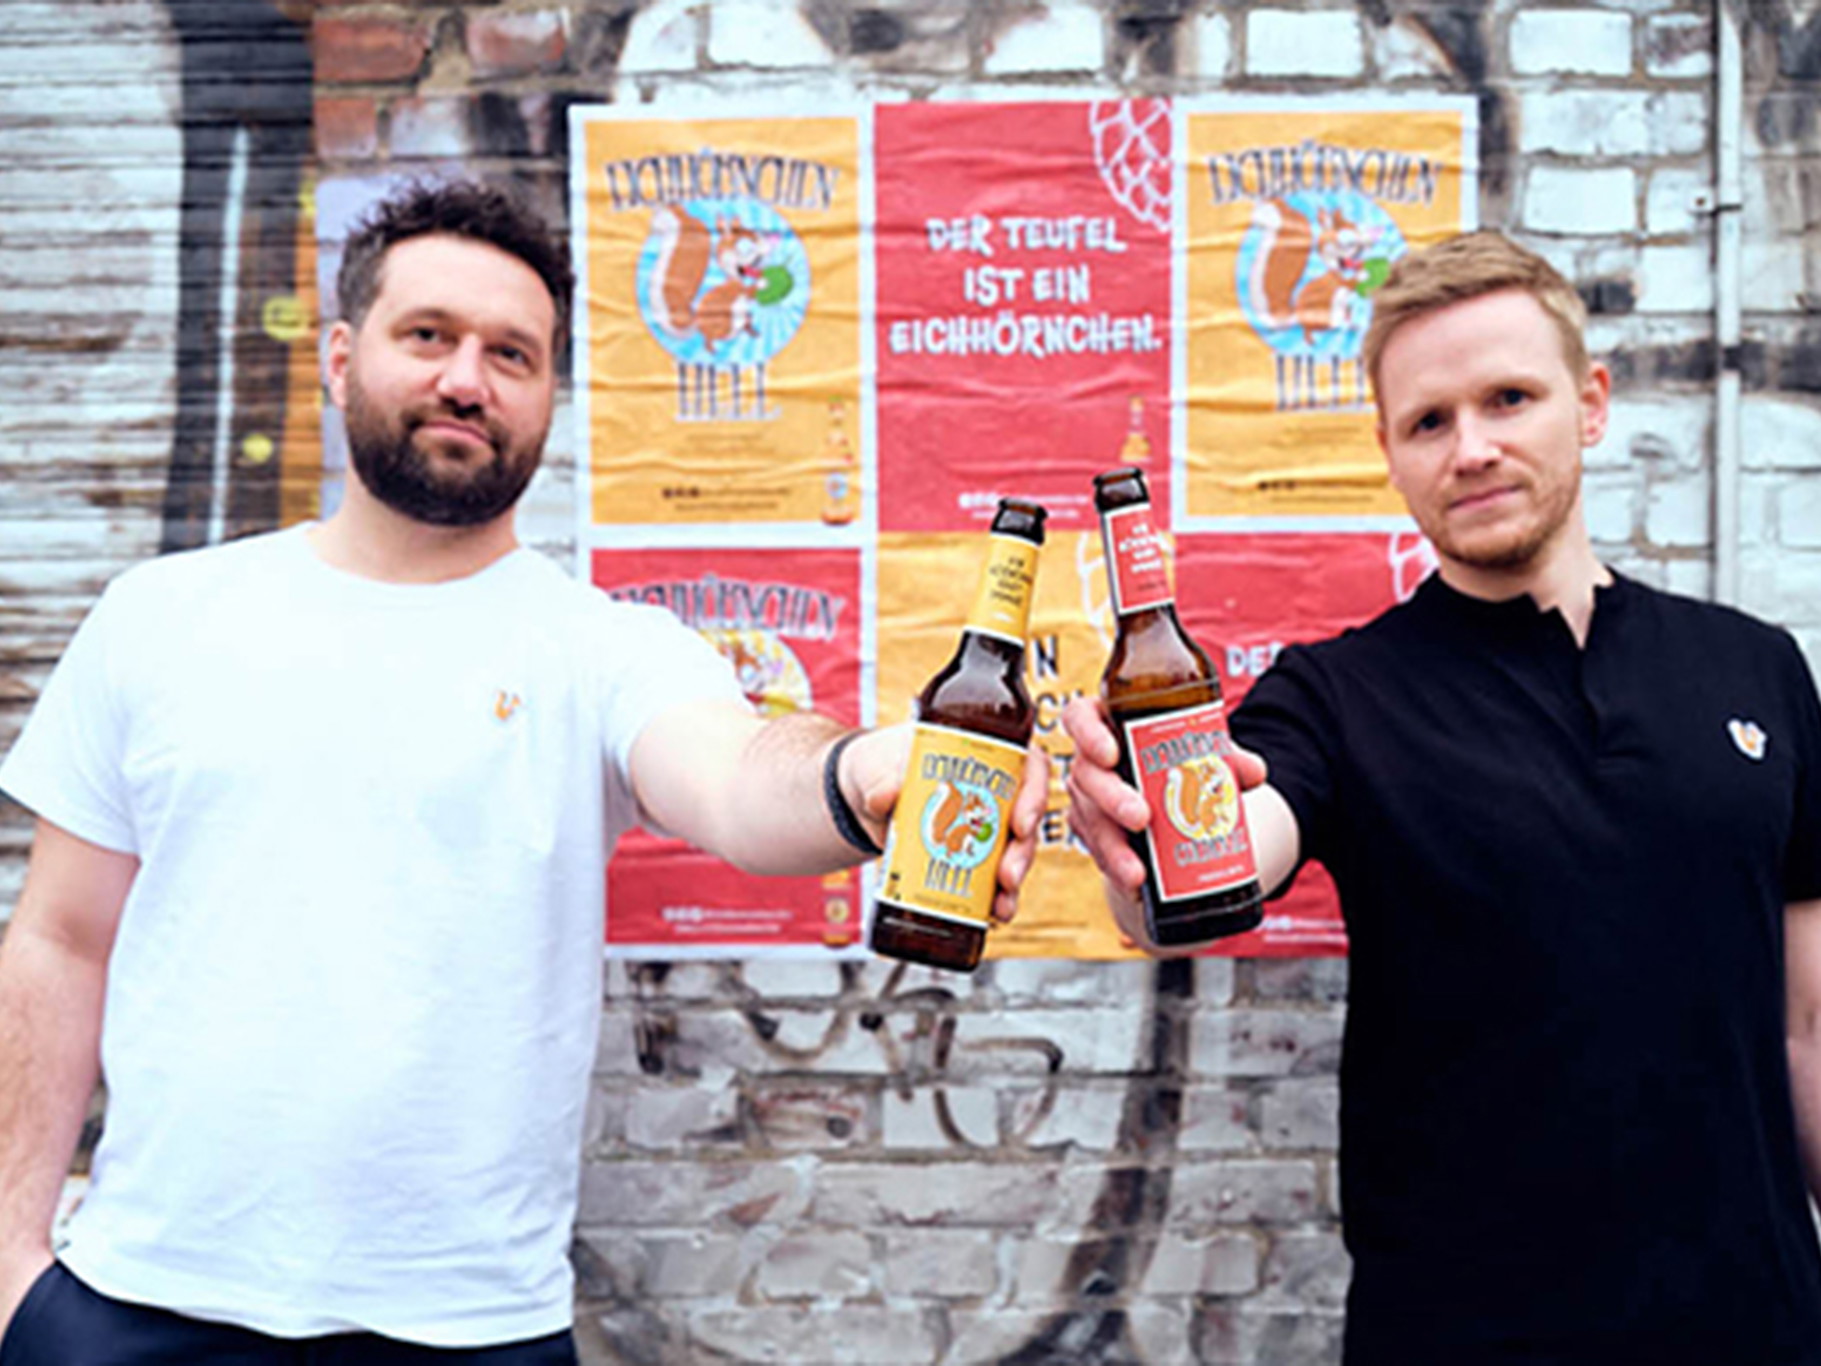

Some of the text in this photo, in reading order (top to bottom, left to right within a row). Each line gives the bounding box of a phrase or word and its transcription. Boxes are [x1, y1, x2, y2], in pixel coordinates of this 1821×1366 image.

[925, 214, 1127, 257] DER TEUFEL
[963, 263, 1089, 307] IST EIN
[890, 311, 1161, 357] EICHHÖRNCHEN.
